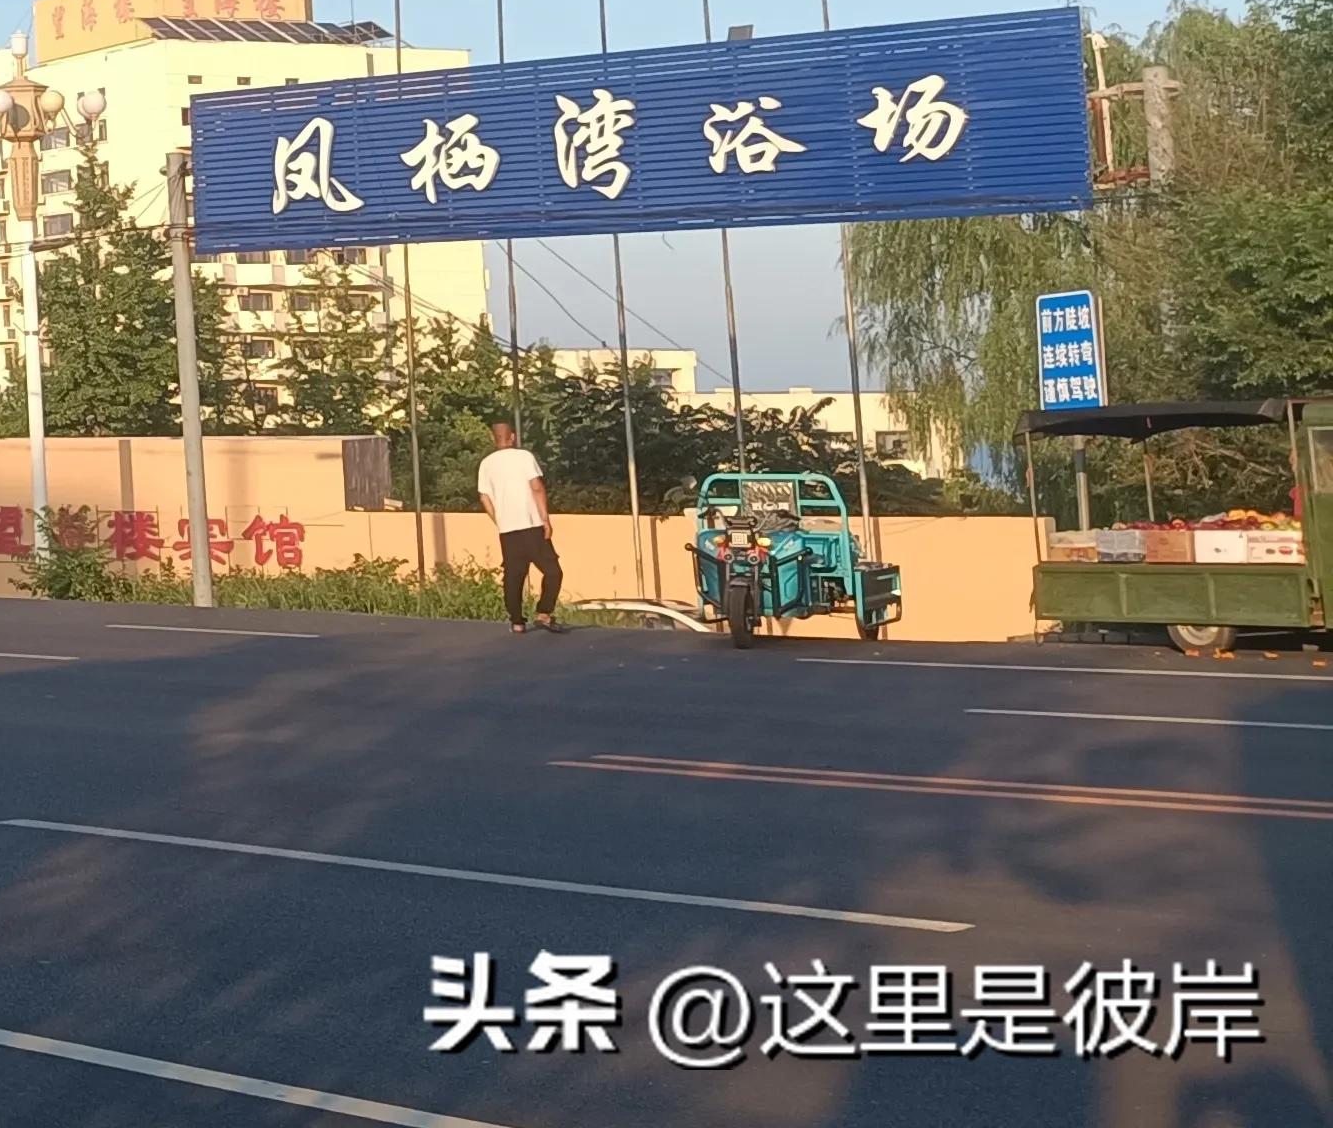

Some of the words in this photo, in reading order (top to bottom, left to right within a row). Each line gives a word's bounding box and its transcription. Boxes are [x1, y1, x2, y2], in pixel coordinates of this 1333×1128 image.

[272, 74, 969, 214] 凤栖湾浴场
[1041, 305, 1091, 333] 前方陡坡
[1043, 340, 1093, 368] 连续转弯
[1044, 375, 1098, 403] 谨慎驾驶
